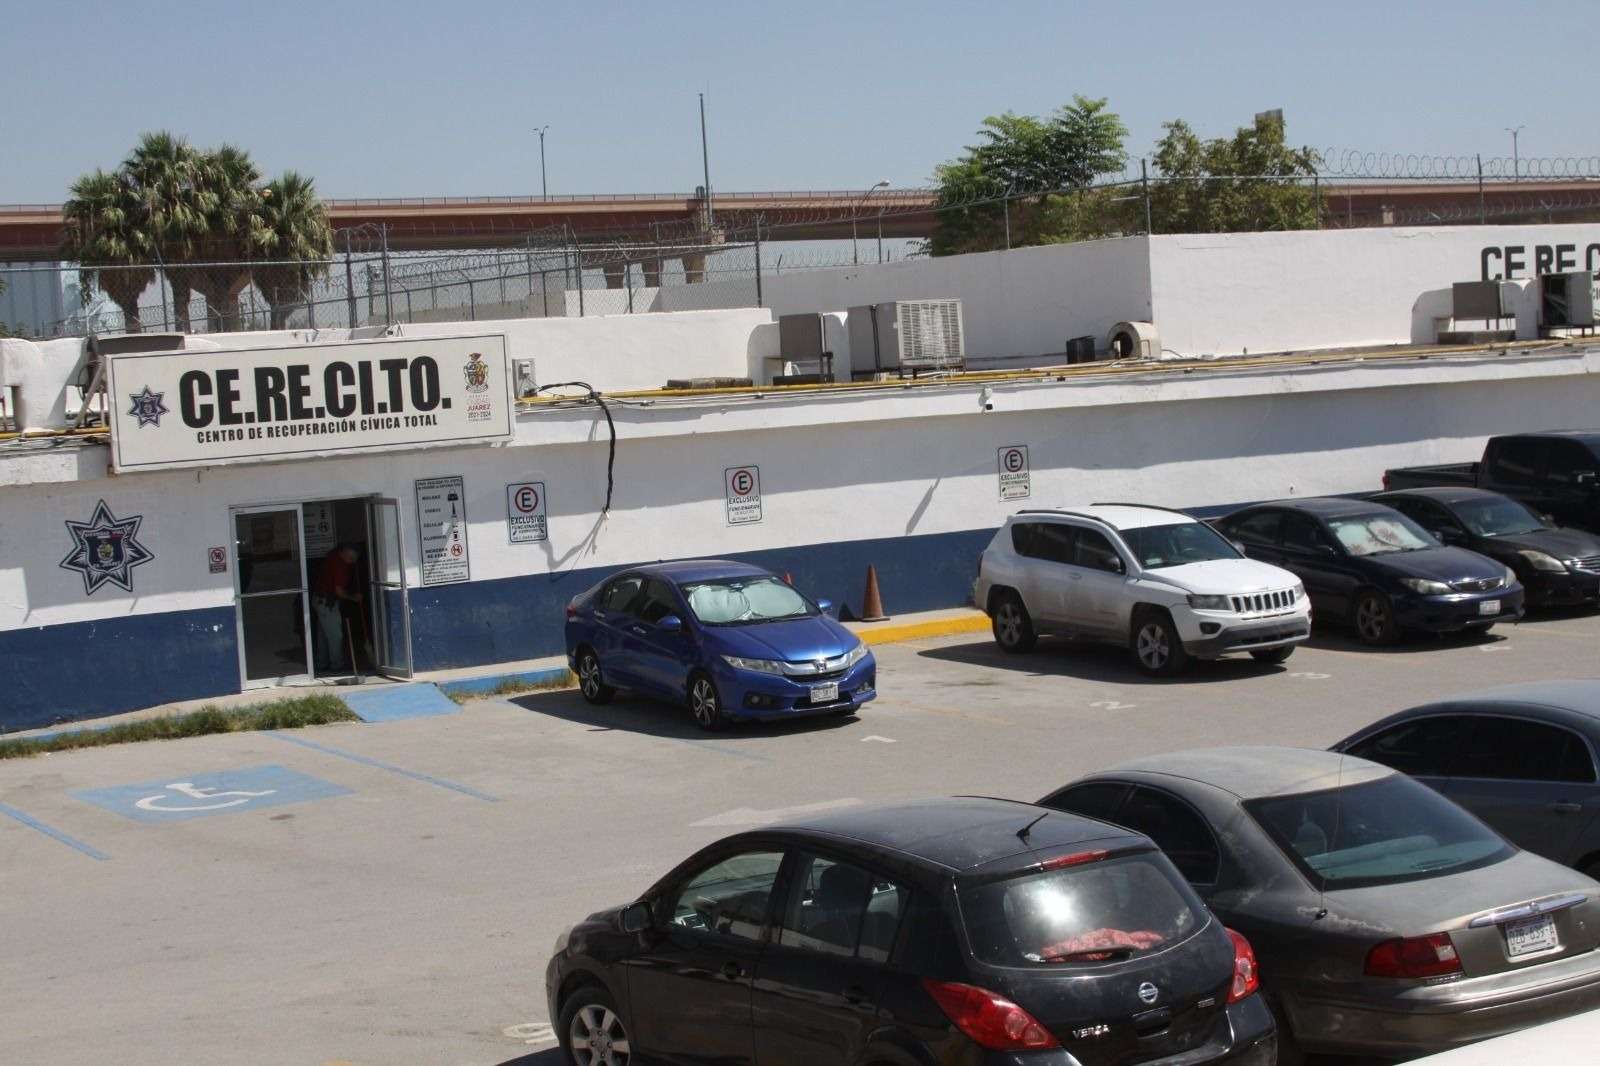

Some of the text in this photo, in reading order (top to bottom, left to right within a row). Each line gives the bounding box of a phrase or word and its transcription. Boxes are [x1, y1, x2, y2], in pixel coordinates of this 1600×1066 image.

[179, 355, 451, 429] CE.RE.CI.TO.
[197, 414, 438, 444] CENTRO DE RECUPERACIÓN CÍVICA TOTAL
[1010, 453, 1018, 468] E
[738, 475, 748, 490] E
[522, 492, 532, 508] E
[729, 496, 760, 504] EXCLUSIVO
[511, 514, 545, 525] EXCLUSIVO
